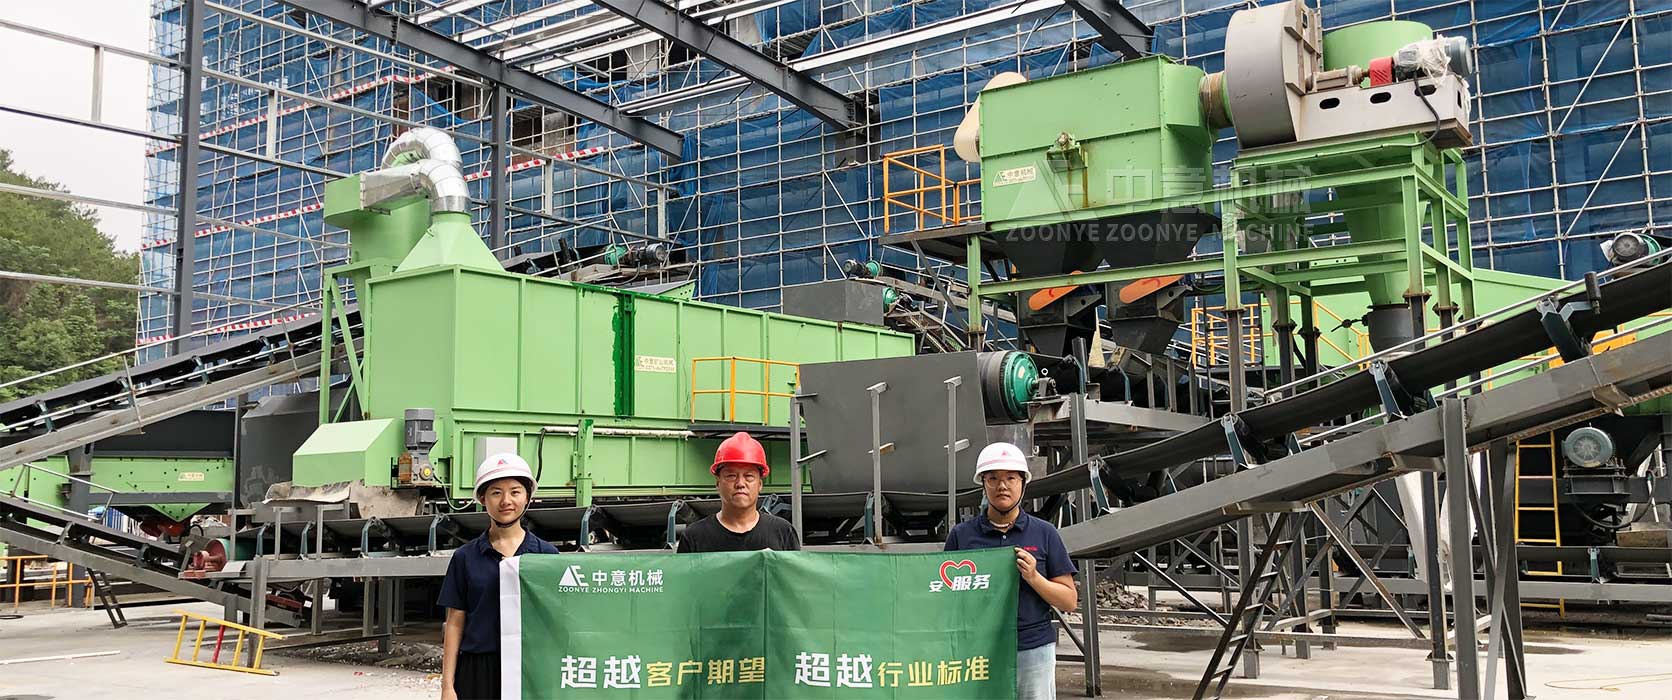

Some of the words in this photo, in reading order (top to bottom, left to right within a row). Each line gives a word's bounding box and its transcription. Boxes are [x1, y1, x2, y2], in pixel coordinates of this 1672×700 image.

[592, 569, 664, 586] 中意机械
[560, 655, 766, 689] 超越客户期望
[794, 652, 990, 688] 超越行业标准
